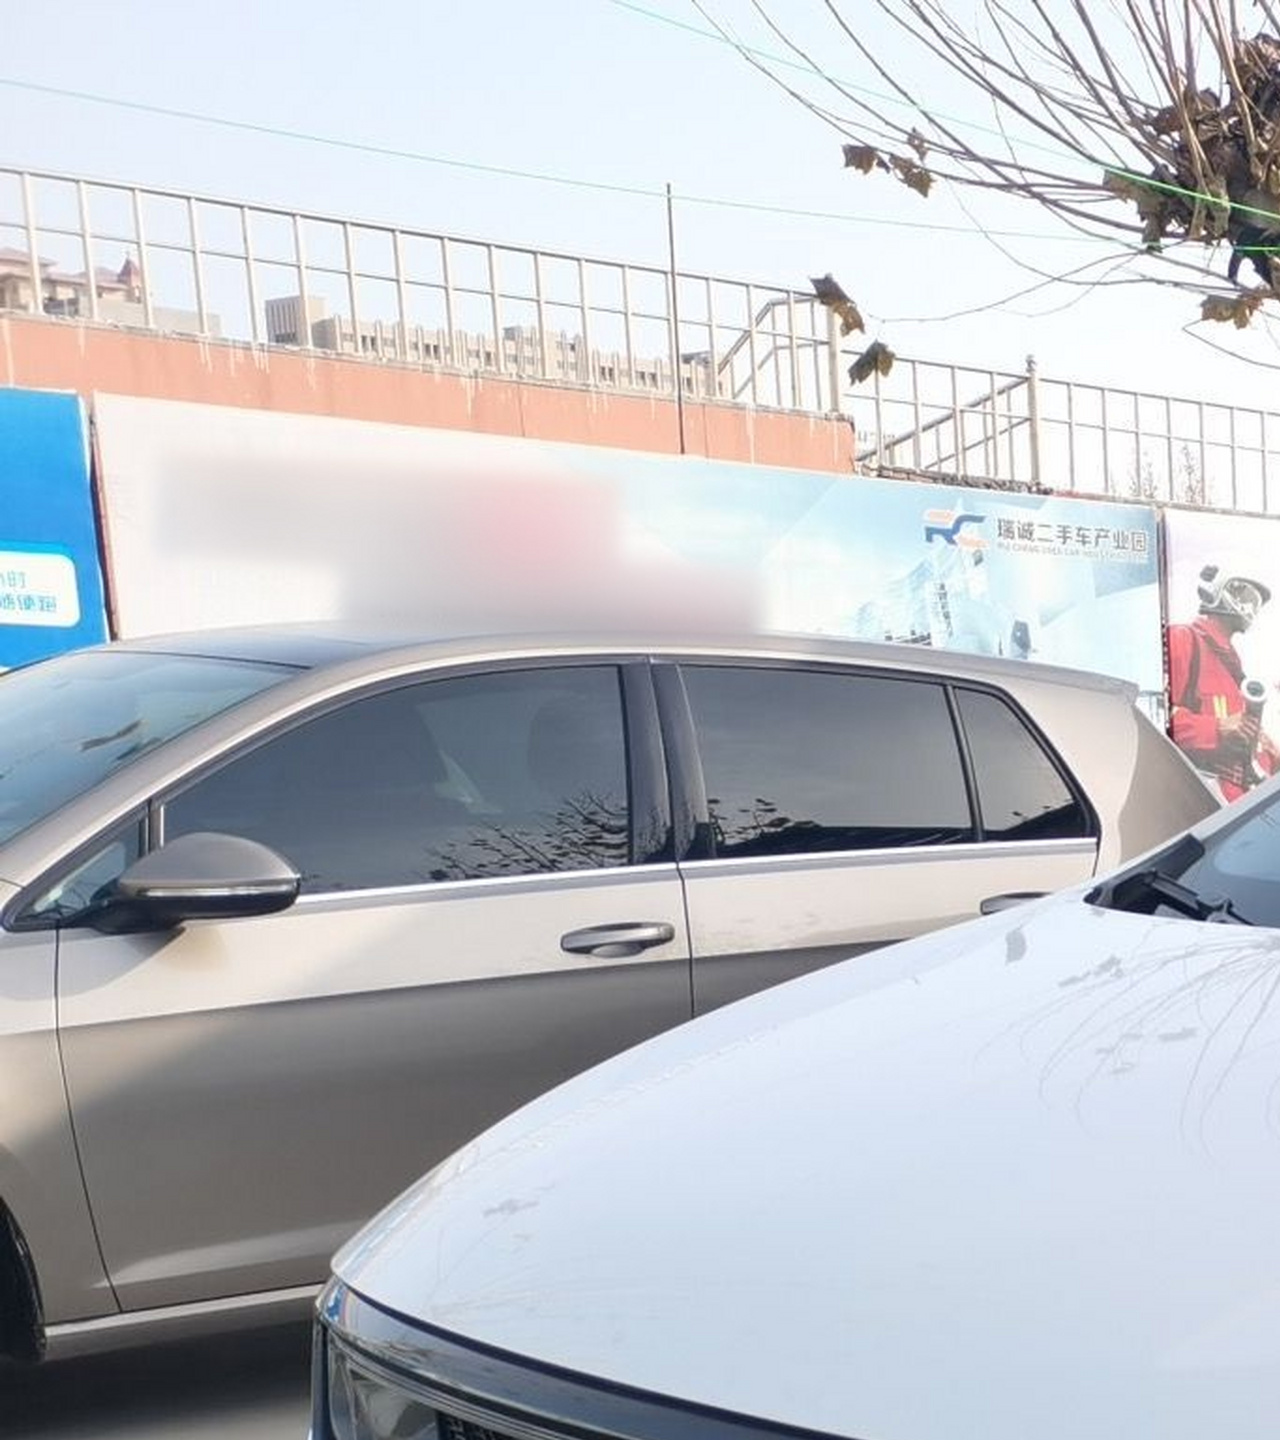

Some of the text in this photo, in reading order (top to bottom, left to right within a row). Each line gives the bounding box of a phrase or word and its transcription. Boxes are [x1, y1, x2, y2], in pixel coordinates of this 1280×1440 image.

[997, 518, 1147, 551] 瑞诚二手车产业园
